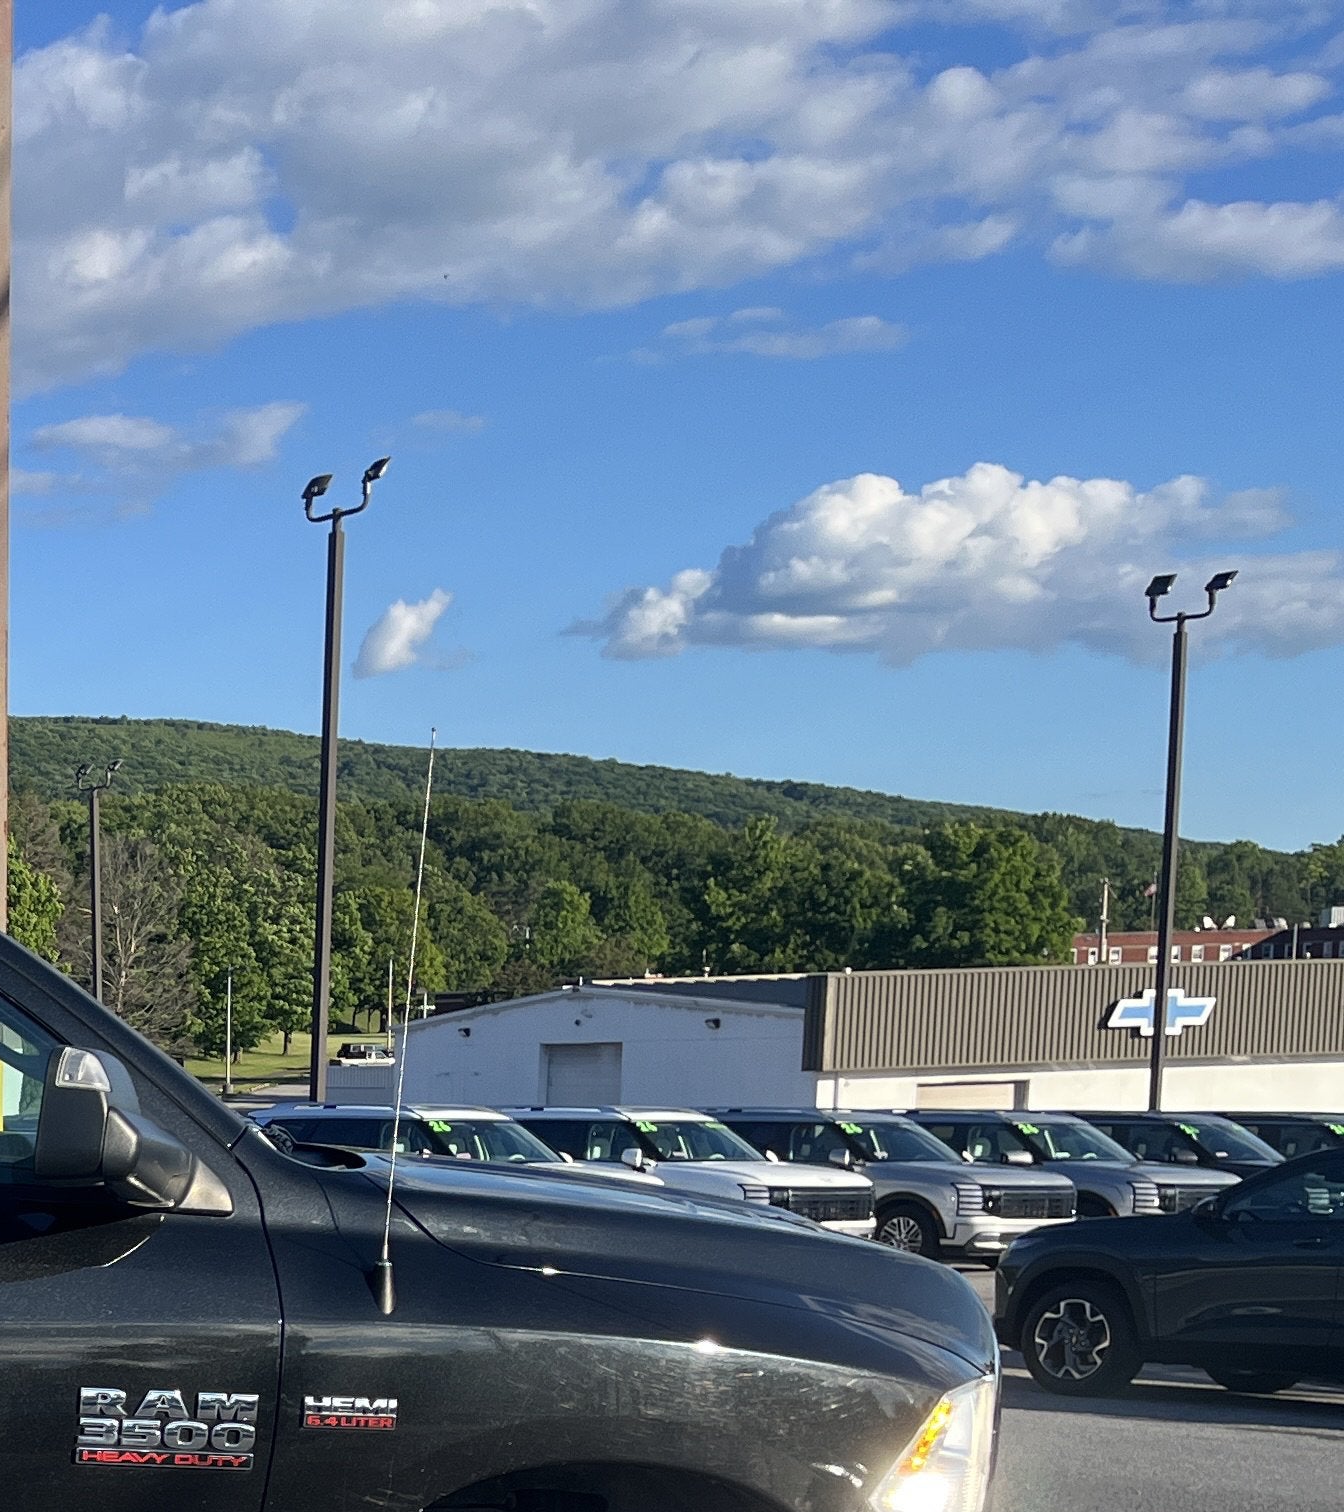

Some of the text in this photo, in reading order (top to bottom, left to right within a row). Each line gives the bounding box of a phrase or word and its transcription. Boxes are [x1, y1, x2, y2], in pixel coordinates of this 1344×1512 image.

[80, 1387, 259, 1421] RAM
[304, 1396, 398, 1417] HEMI
[307, 1415, 393, 1428] 6.4 LITER
[77, 1417, 256, 1451] 3500
[81, 1450, 248, 1467] HEAVY DUTY
